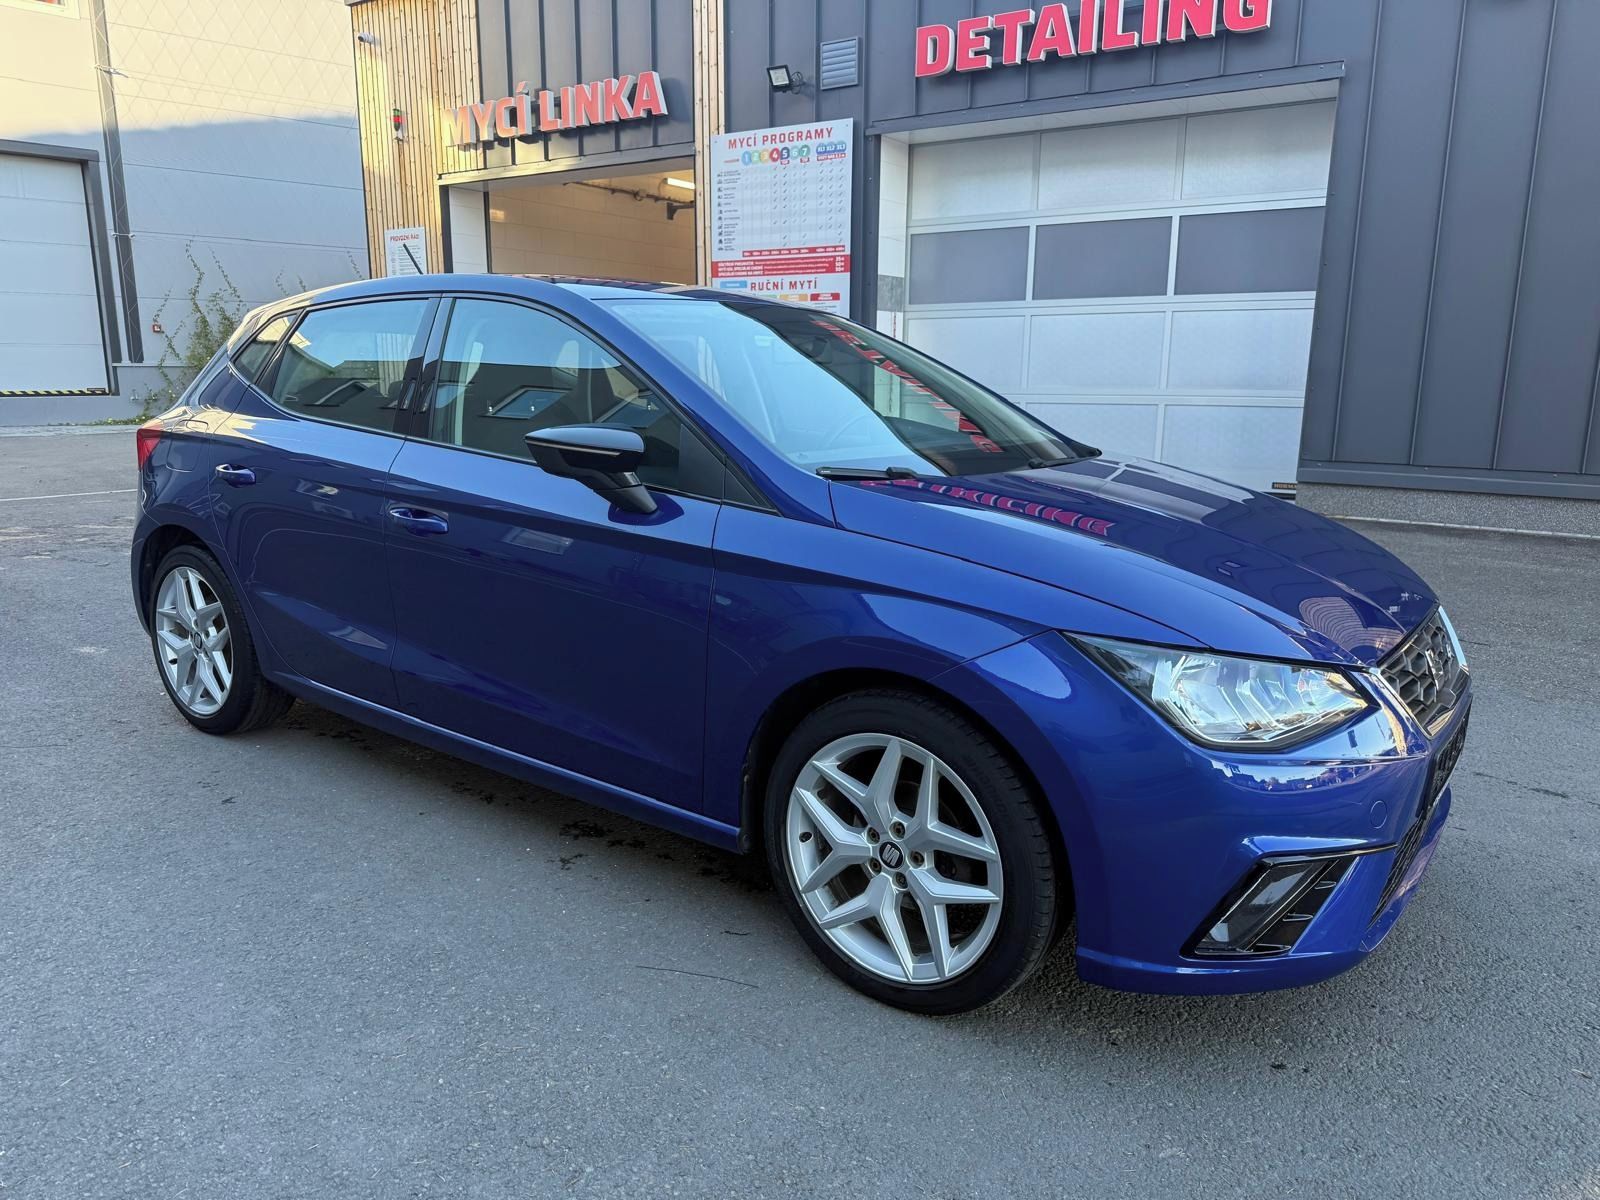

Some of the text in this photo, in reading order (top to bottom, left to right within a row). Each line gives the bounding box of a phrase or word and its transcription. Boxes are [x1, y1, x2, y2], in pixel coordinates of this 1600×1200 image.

[915, 0, 1271, 78] DETAILING
[443, 71, 668, 145] MYCÍ LINKA
[728, 127, 833, 149] MYCÍ PROGRAMY
[750, 277, 817, 291] RUČNÍ MYTÍ
